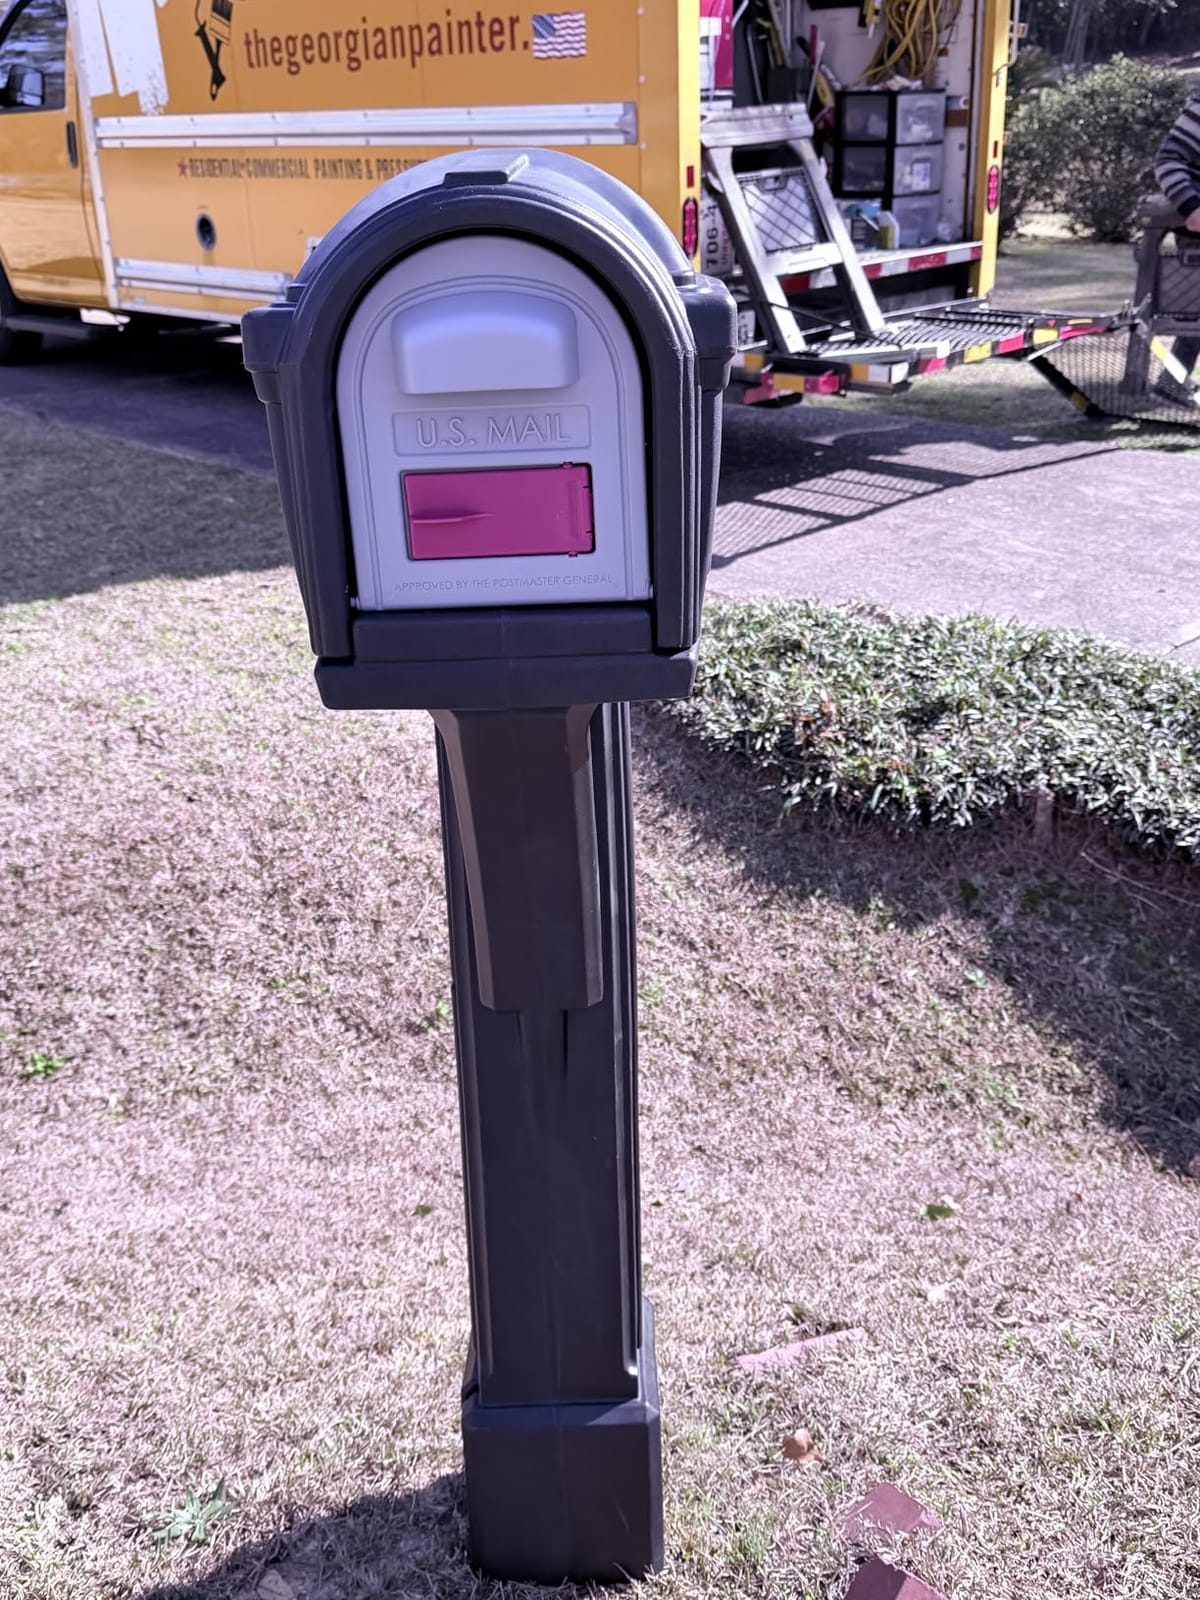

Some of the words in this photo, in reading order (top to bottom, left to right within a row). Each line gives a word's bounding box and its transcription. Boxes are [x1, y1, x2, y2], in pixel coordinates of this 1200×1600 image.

[245, 9, 529, 76] thegeorgianpainter.
[314, 158, 362, 179] PAINTING
[366, 158, 375, 179] &
[416, 416, 476, 448] U.S.
[488, 412, 569, 445] MAIL
[394, 580, 454, 592] APPROVED
[456, 579, 469, 591] BY
[472, 578, 490, 590] THE
[493, 575, 561, 588] POSTMASTER
[563, 573, 614, 586] GENERAL
